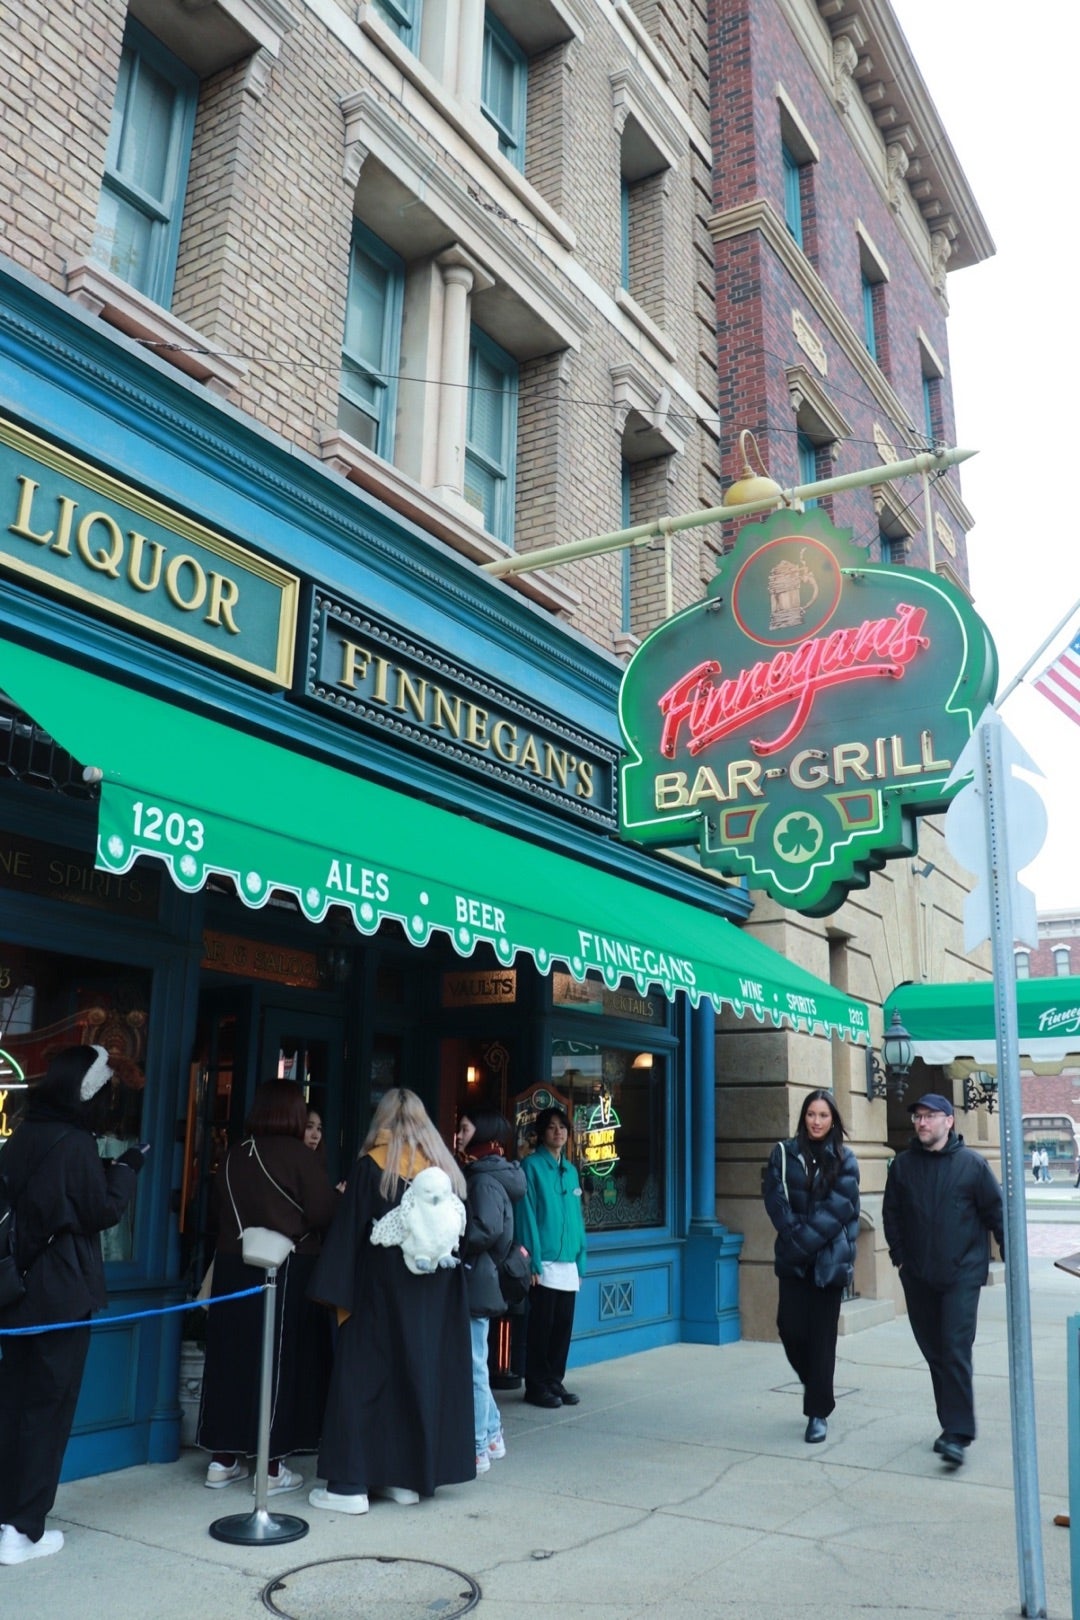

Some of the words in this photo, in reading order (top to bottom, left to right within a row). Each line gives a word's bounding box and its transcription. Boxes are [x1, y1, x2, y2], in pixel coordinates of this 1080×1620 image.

[9, 475, 241, 634] LIQUOR
[339, 639, 596, 799] FINNEGAN'S
[48, 858, 144, 905] SPIRITS
[133, 801, 205, 852] 1203
[326, 859, 390, 902] ALES
[455, 895, 507, 934] BEER
[577, 929, 697, 986] FINNEGAN'S
[739, 977, 764, 1003] WINE
[786, 991, 817, 1016] SPIRITS
[848, 1007, 865, 1027] 1203
[448, 978, 514, 998] VAULTS
[602, 992, 655, 1018] OCKTAILS
